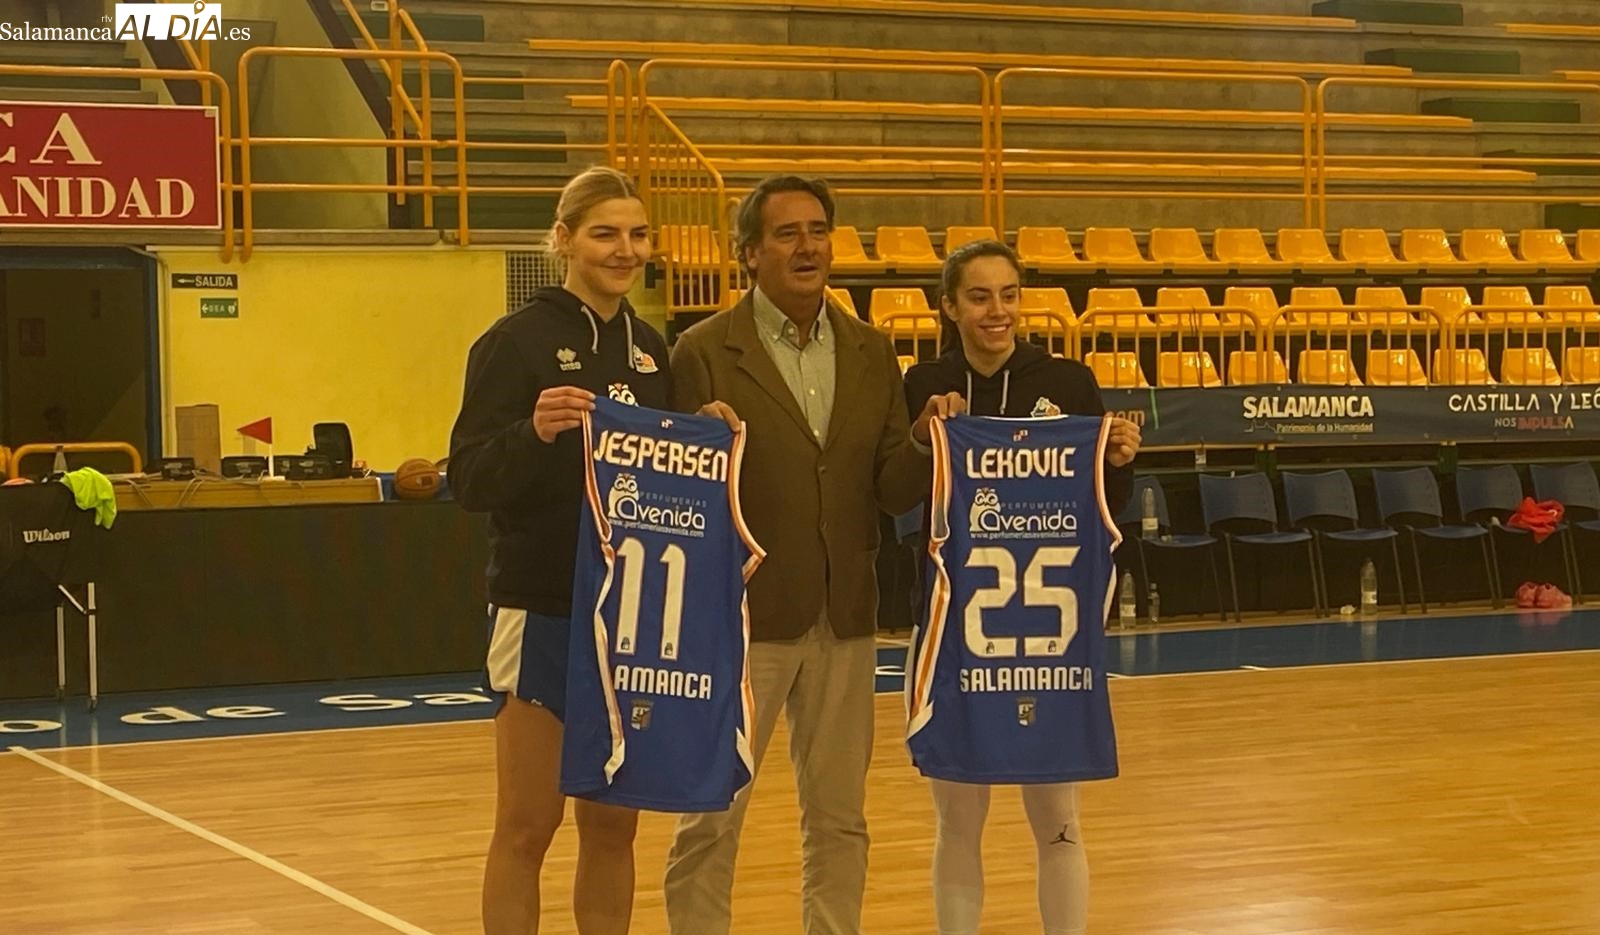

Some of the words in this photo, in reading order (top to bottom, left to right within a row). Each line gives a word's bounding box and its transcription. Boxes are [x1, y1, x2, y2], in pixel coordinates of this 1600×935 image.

[195, 275, 234, 288] SALIDA
[1243, 396, 1374, 418] SALAMANCA
[1448, 393, 1540, 412] CASTILLA
[1549, 393, 1562, 414] Y
[1494, 417, 1517, 428] NOS
[593, 429, 728, 483] JESPERSEN
[966, 448, 1076, 479] LEKOVIC
[23, 528, 70, 543] Wilson
[615, 536, 687, 661] 11
[964, 545, 1081, 659] 25
[959, 666, 1093, 692] SALAMANCA
[120, 706, 286, 724] de
[318, 687, 494, 711] Sa
